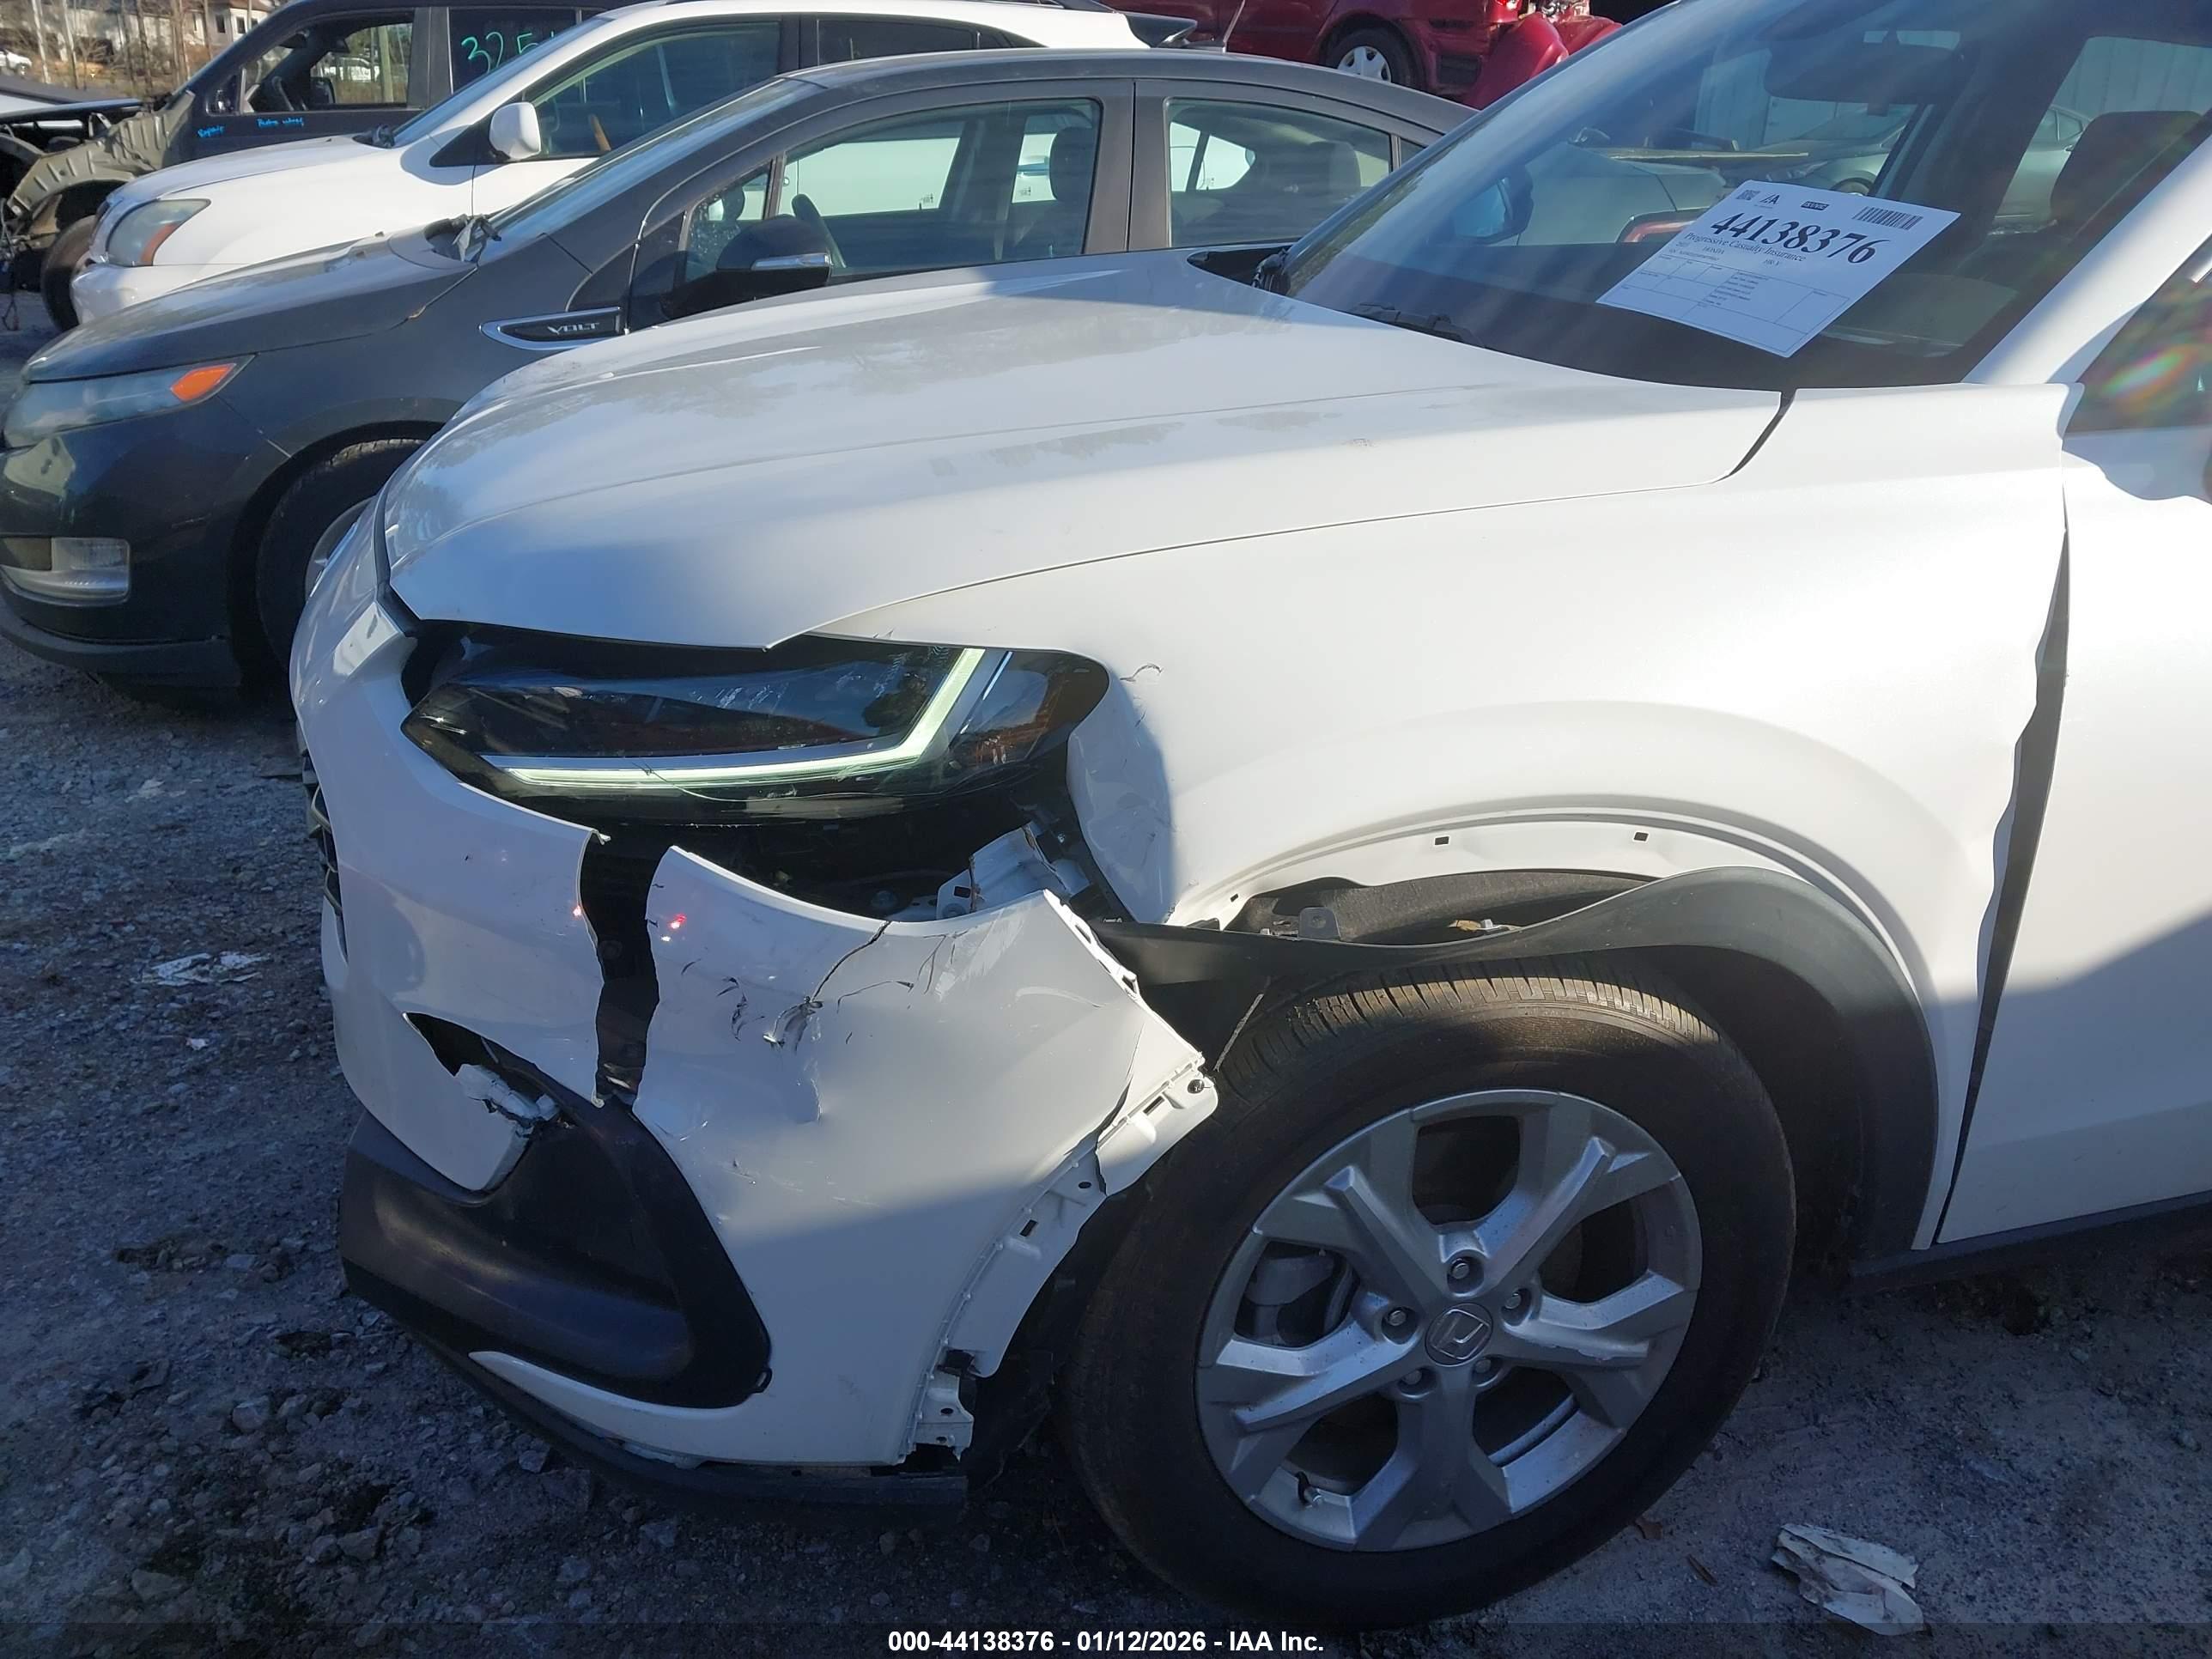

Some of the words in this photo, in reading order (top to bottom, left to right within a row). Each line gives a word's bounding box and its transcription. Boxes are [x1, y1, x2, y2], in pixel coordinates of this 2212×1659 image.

[1684, 232, 1729, 246] Progressive
[1729, 240, 1762, 255] Casualty
[1764, 246, 1807, 262] Insurance
[1711, 212, 1890, 264] 44138376
[547, 323, 599, 334] VOLT
